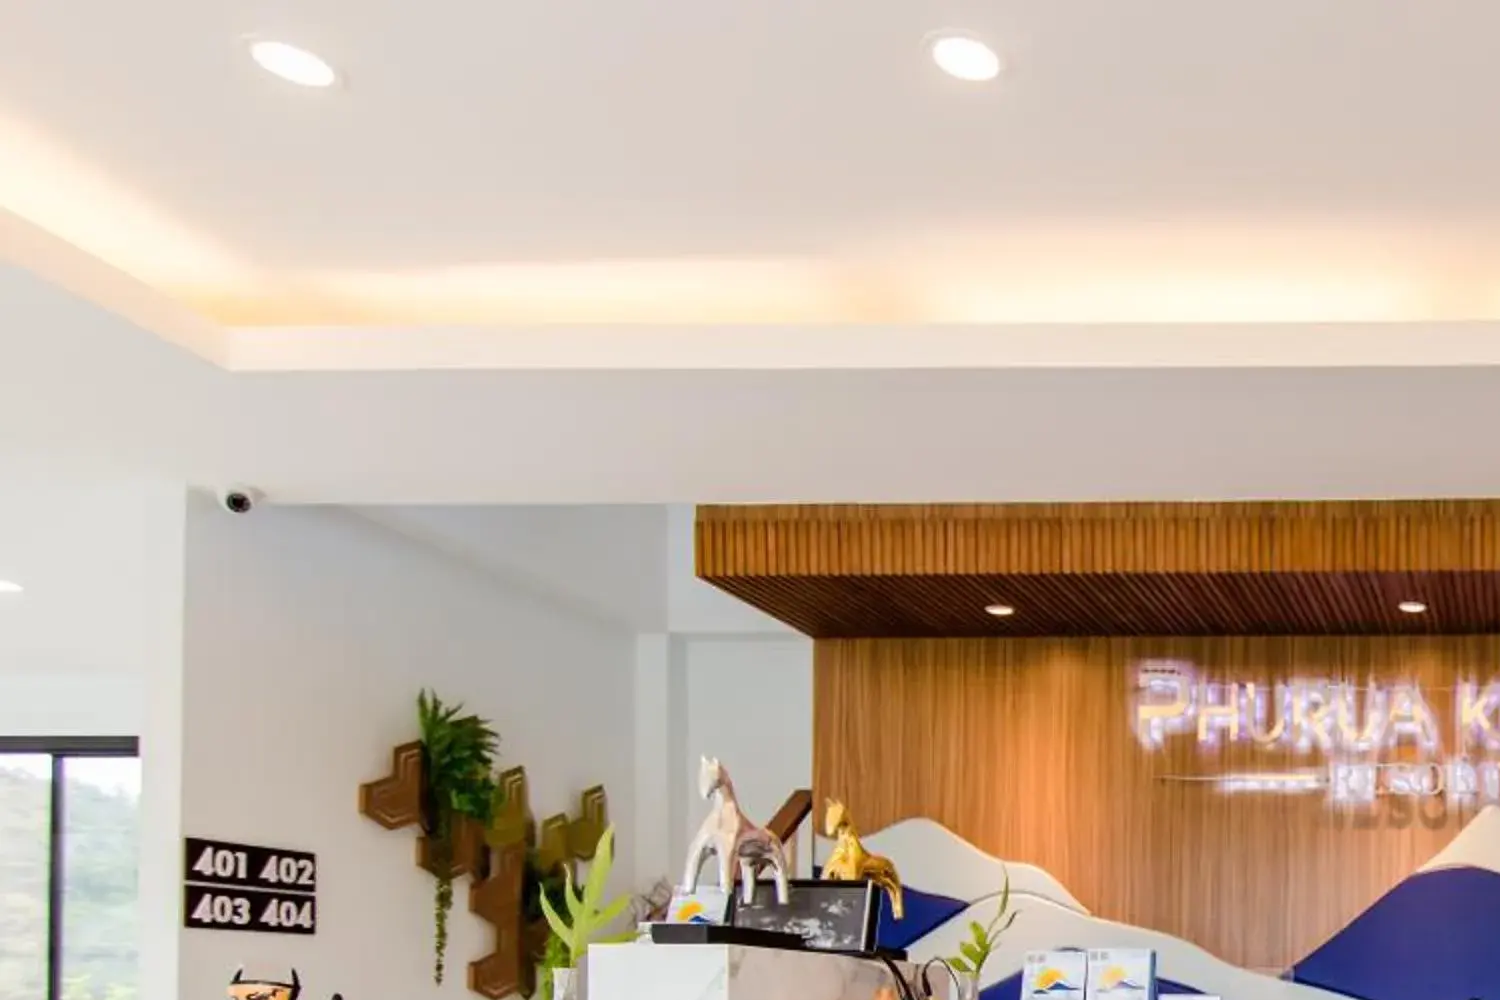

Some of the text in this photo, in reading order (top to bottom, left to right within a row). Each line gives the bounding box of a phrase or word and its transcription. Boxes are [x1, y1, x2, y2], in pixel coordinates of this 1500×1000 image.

[1136, 662, 1434, 750] PHURUA
[192, 845, 314, 886] 401 402
[191, 893, 313, 929] 403 404
